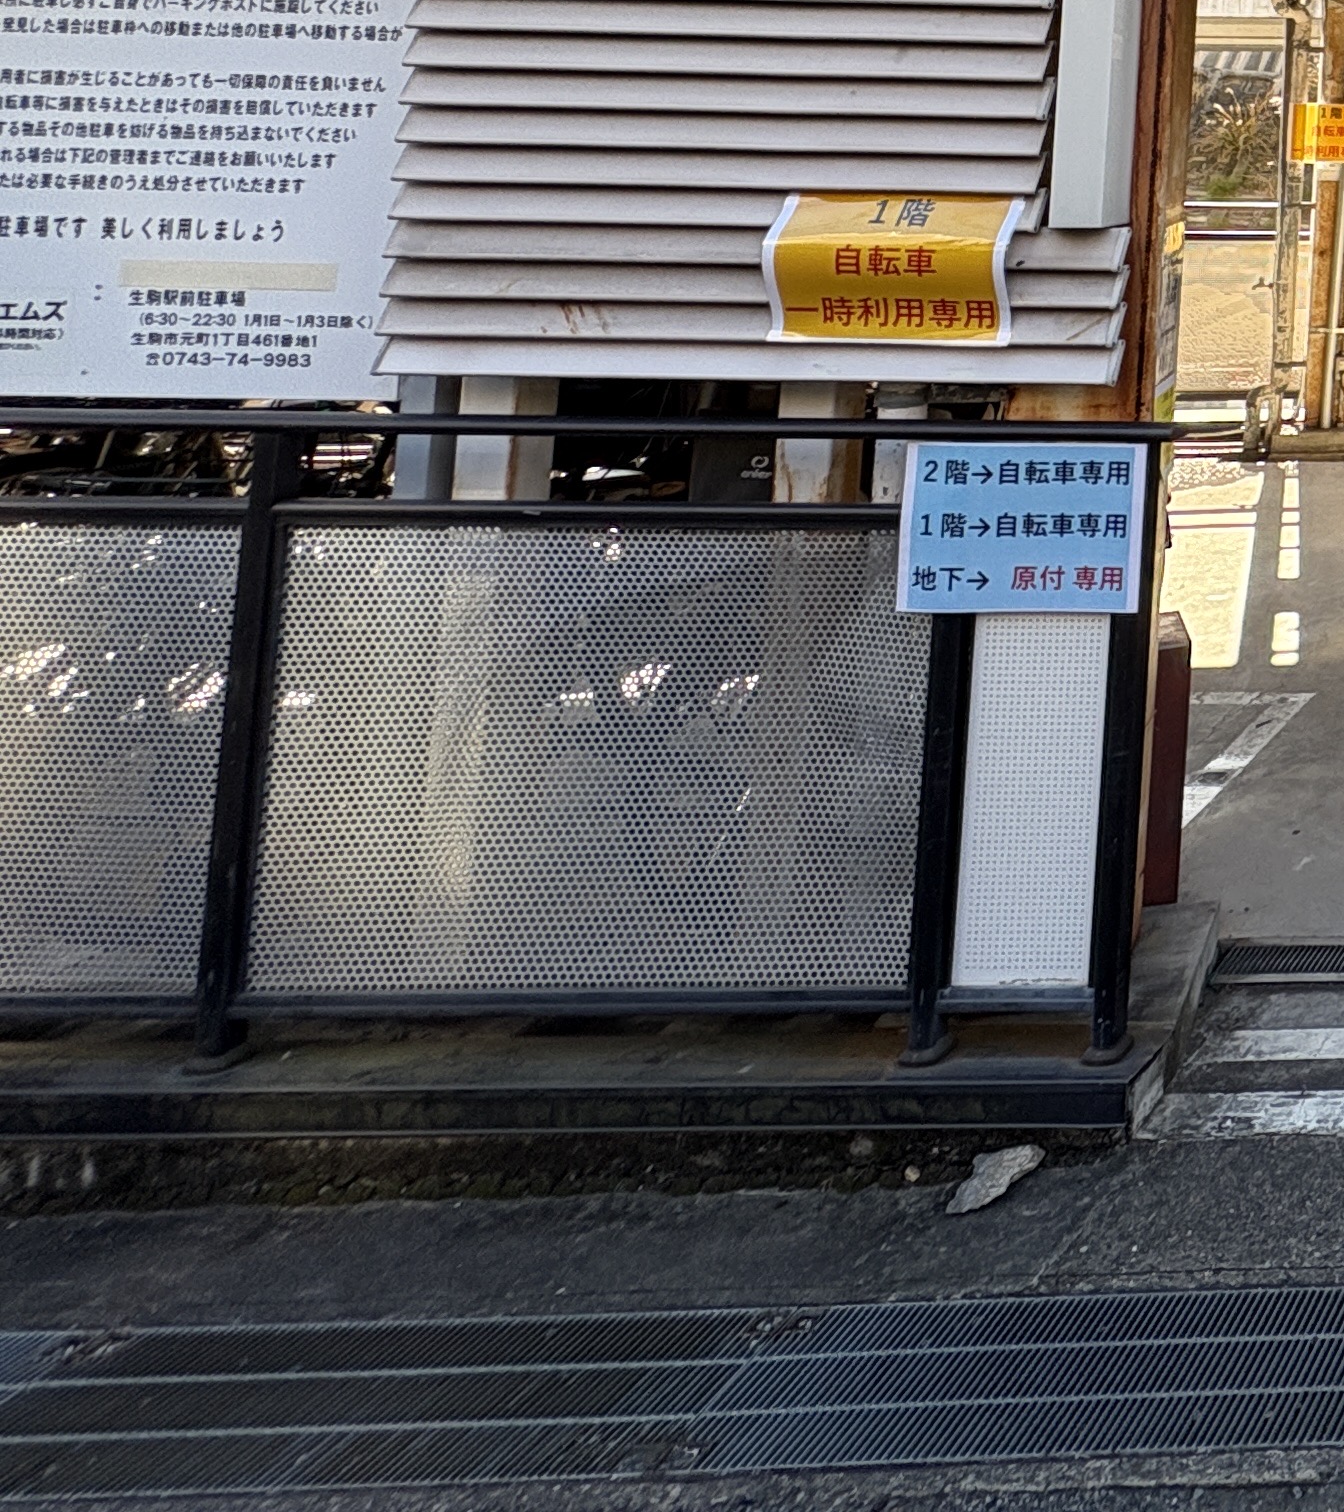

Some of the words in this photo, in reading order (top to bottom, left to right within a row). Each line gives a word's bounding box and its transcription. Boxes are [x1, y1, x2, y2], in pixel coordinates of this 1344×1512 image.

[868, 198, 935, 228] 1階
[100, 217, 284, 242] 美しく利用しましょう
[834, 245, 937, 277] 自転車
[128, 289, 246, 307] 生駒駅前駐車場
[785, 296, 996, 329] 一時利用専用
